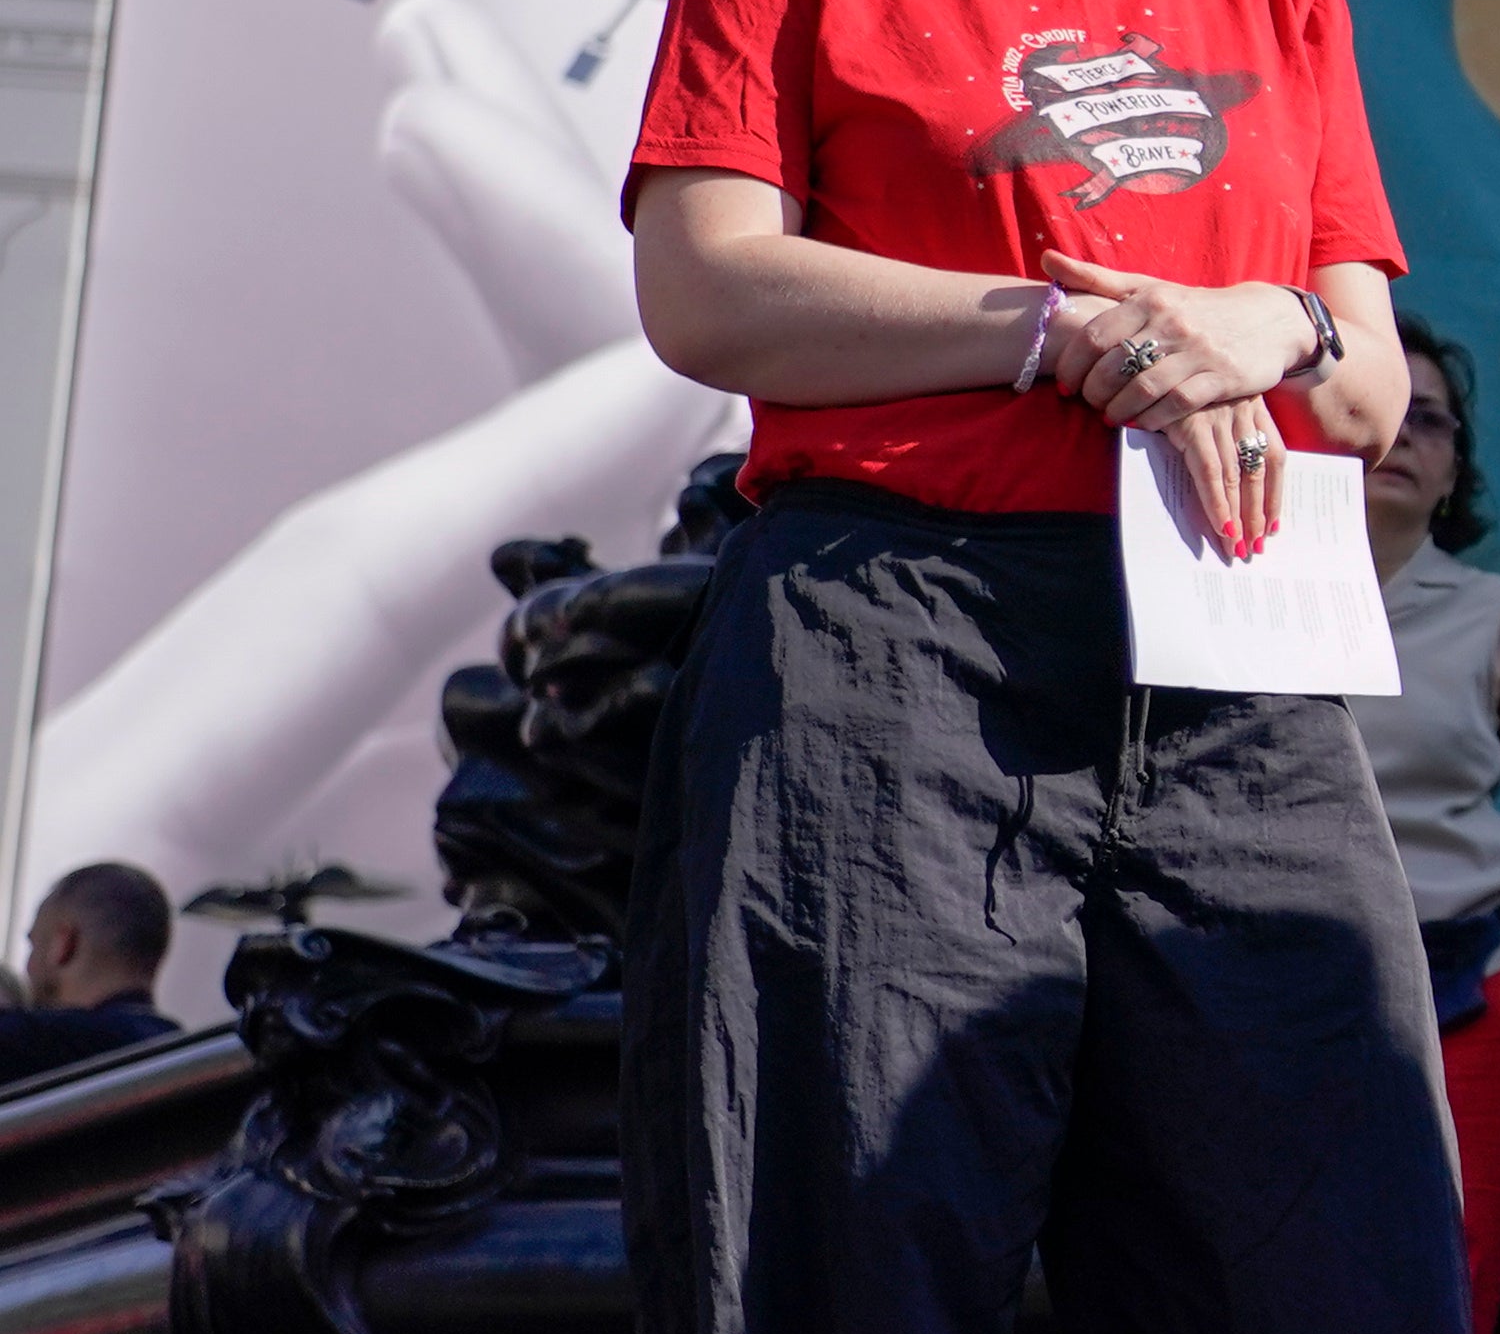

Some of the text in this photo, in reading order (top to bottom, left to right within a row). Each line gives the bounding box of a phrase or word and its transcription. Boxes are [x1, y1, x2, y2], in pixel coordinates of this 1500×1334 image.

[1001, 46, 1024, 73] 2022
[1020, 28, 1087, 49] CARDIFF
[1067, 62, 1123, 86] FIERCE
[1074, 93, 1173, 123] POWERFUL
[1119, 144, 1177, 169] BRAVE
